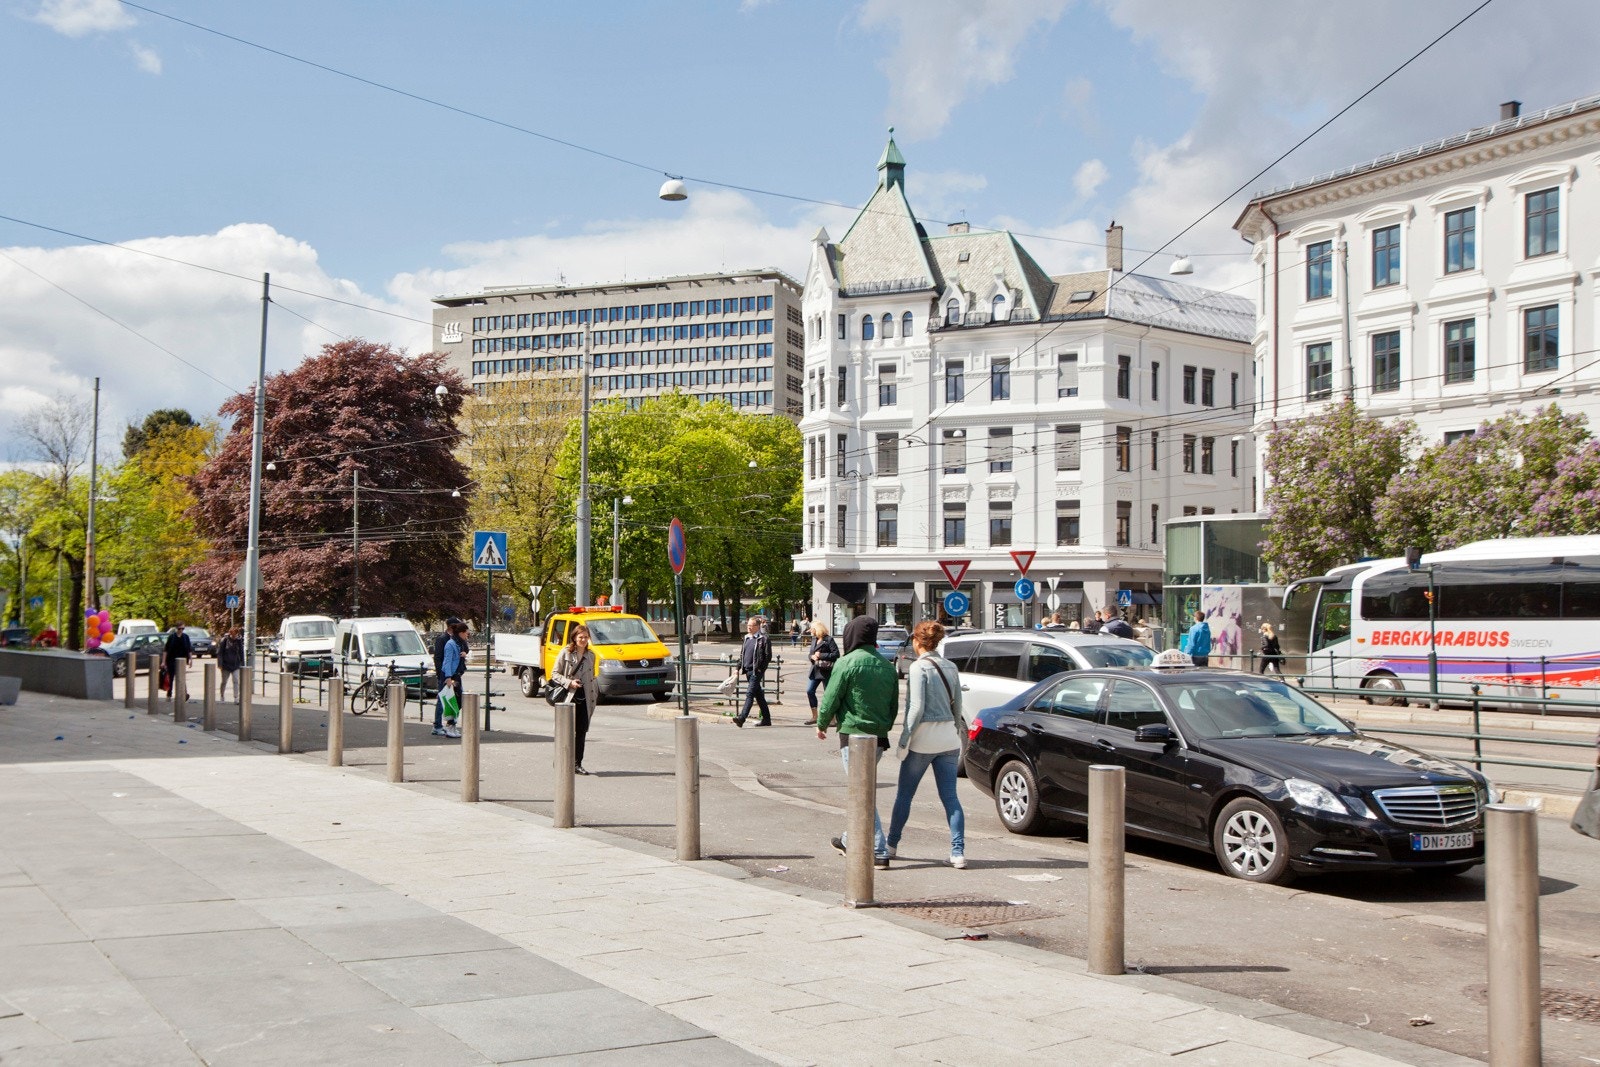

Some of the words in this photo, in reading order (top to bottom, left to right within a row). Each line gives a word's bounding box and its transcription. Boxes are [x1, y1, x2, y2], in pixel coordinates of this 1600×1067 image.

[1371, 631, 1510, 647] BERGKVARABUSS
[1510, 639, 1552, 648] SWEDEN
[1423, 836, 1438, 848] DN
[1444, 834, 1471, 848] 75685
